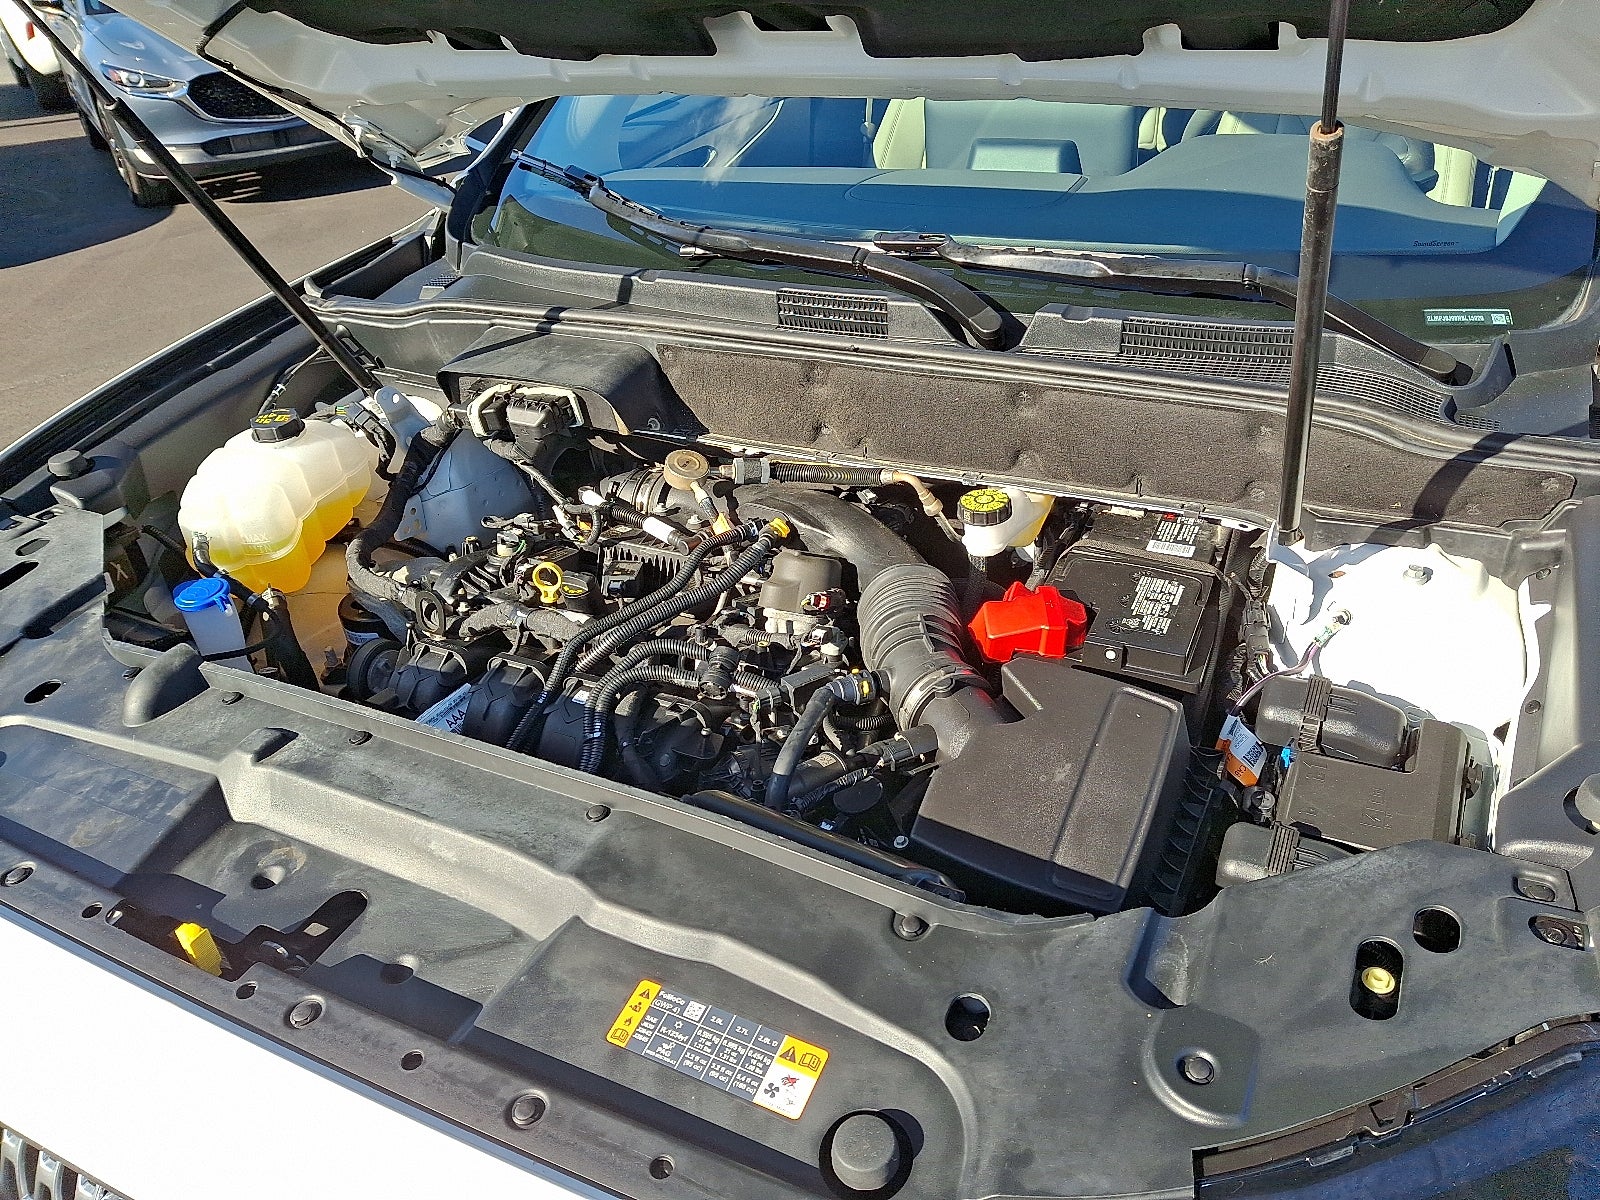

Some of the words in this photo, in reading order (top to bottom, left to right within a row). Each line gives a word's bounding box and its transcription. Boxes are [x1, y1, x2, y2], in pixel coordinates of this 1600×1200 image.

[446, 709, 465, 728] AAA
[652, 999, 673, 1009] (GWP
[736, 1026, 748, 1035] 2.7L
[656, 1047, 671, 1057] PAG
